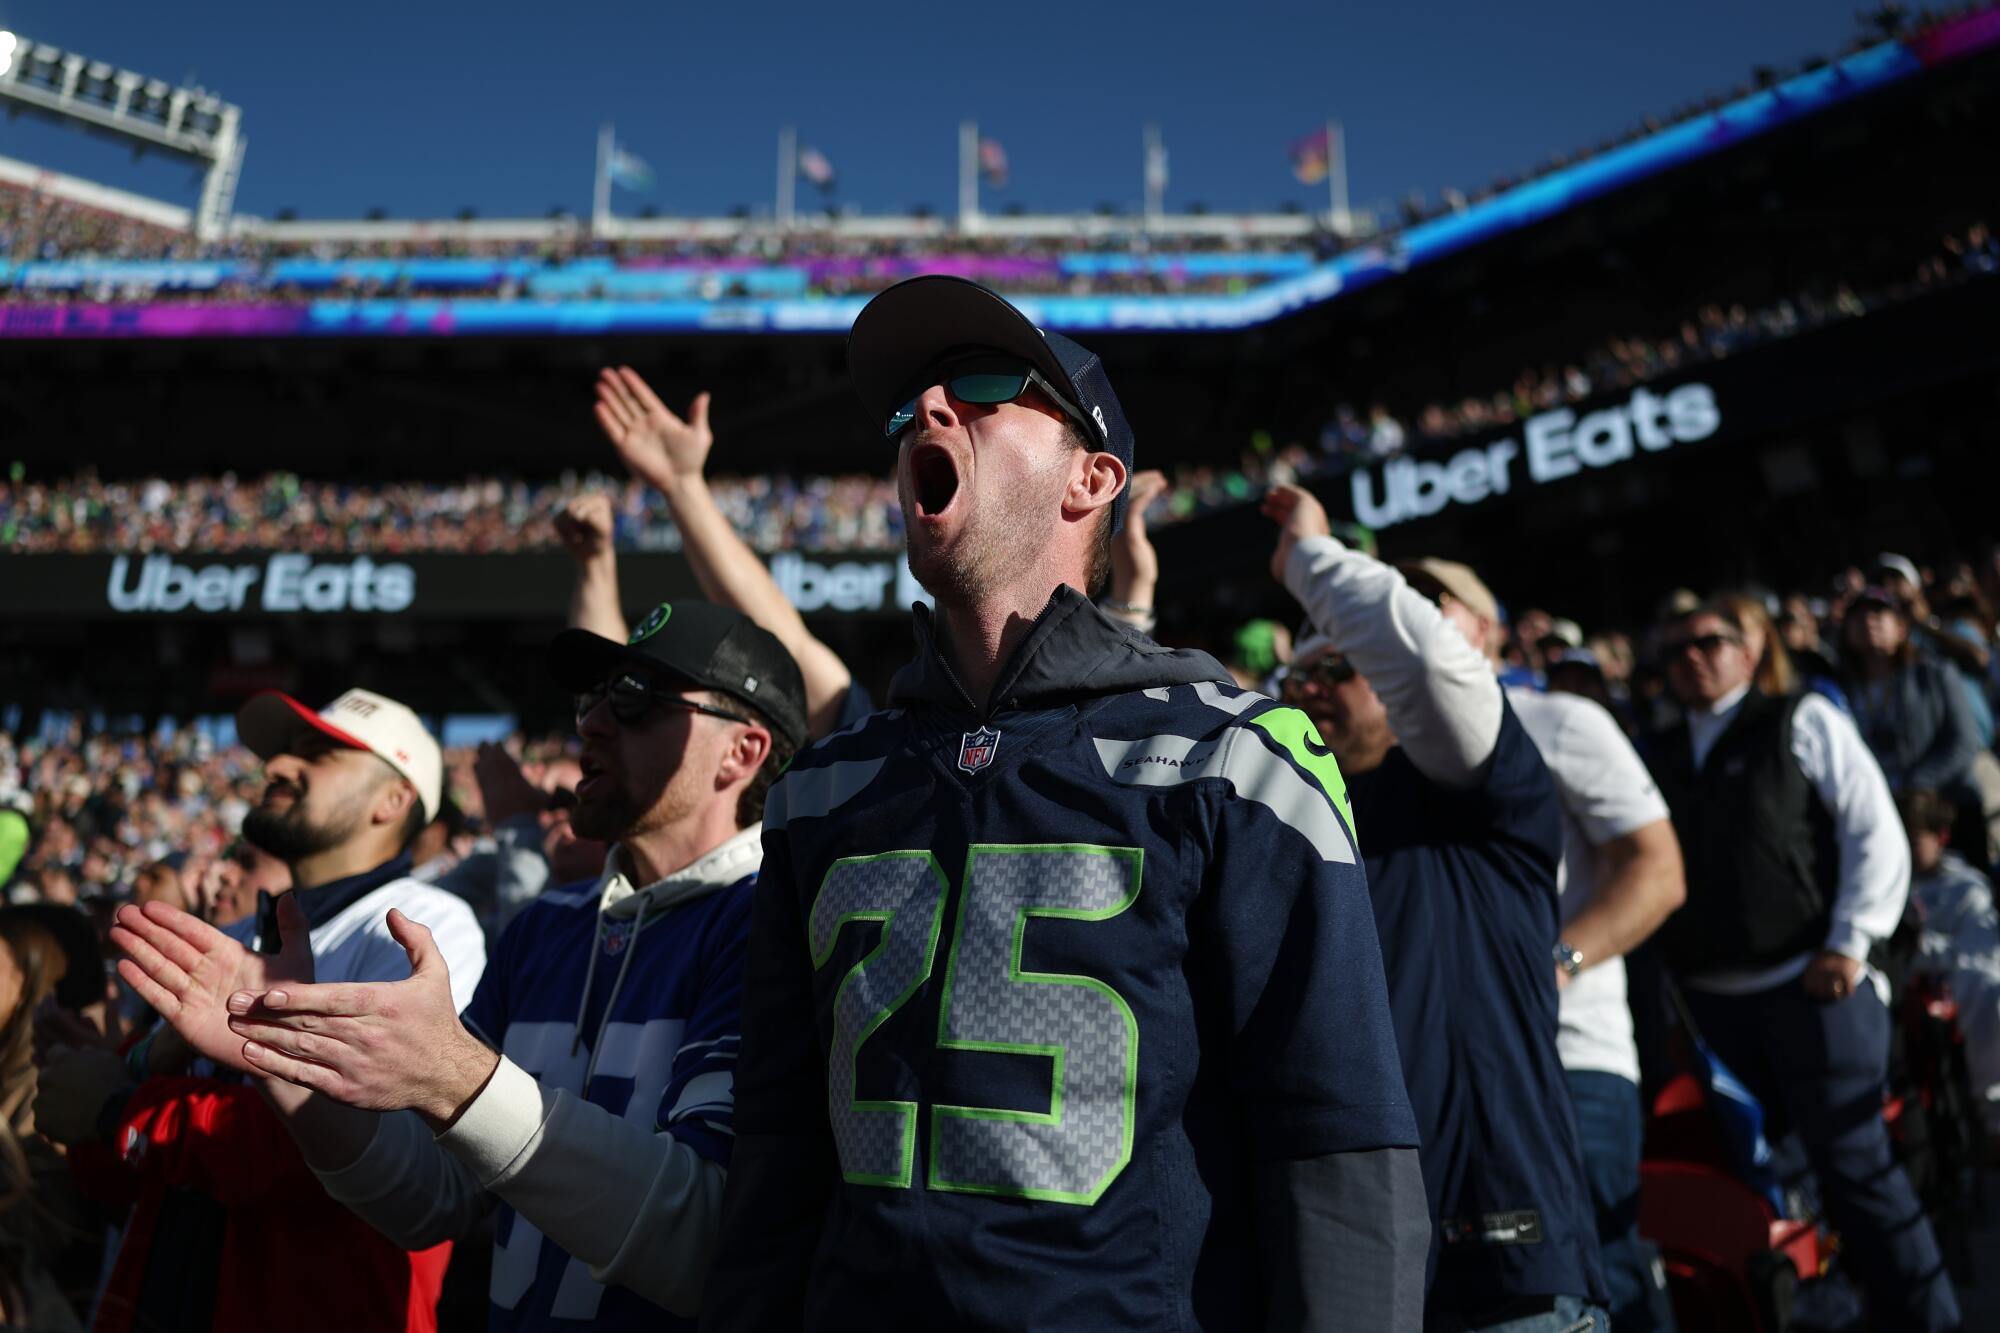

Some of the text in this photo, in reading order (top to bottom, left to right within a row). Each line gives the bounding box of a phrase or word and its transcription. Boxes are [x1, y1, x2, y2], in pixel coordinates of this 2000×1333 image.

[1351, 383, 1721, 529] Uber Eats
[107, 553, 415, 612] Uber Eats
[963, 747, 989, 768] NFL
[809, 843, 1145, 1206] 25
